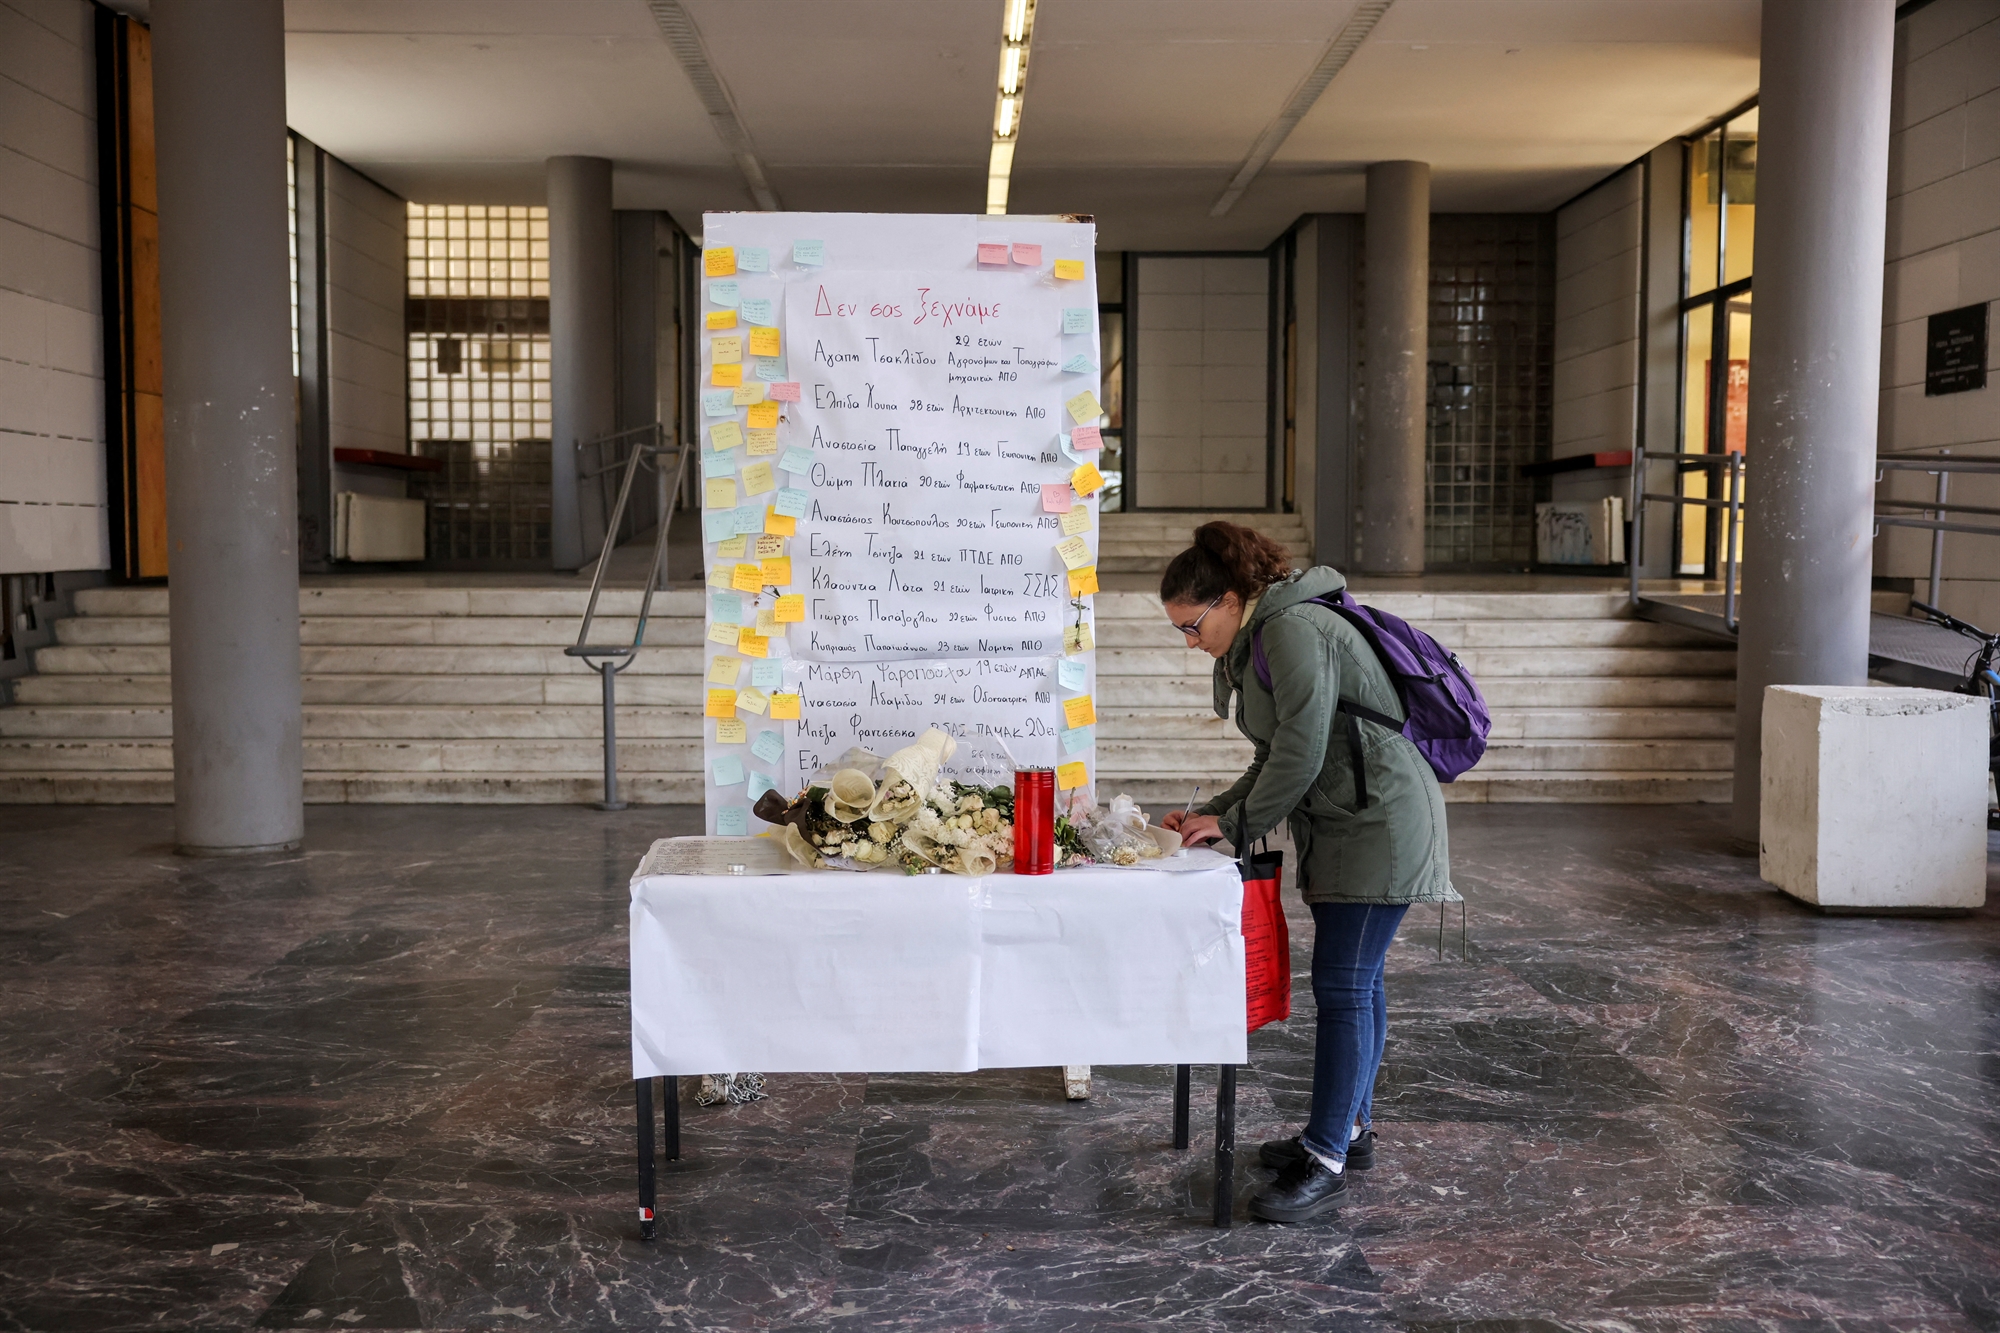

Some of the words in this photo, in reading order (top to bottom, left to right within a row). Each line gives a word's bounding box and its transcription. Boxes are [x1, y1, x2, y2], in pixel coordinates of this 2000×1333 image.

[814, 284, 857, 317] Δεν
[870, 304, 903, 317] σας
[914, 288, 1000, 328] ξεχνάμε
[814, 339, 860, 368] Αγάπη
[865, 337, 936, 364] Τσακλίδου
[1013, 347, 1058, 369] Τοπογράφων
[955, 335, 970, 347] 22
[978, 338, 1002, 347] ετών
[998, 371, 1018, 382] ΑΠΘ
[814, 384, 859, 409] Ελπίδα
[909, 399, 923, 411] 28
[926, 403, 944, 412] ετών
[952, 394, 1017, 417] Αρχιτεκτονική
[1025, 405, 1046, 419] ΑΠΘ
[812, 424, 876, 451] Αναστασία
[886, 428, 947, 460] Παπαγγελή
[957, 441, 970, 456] 19
[974, 448, 991, 457] ετών
[998, 441, 1036, 462] Γεωπονική
[1040, 451, 1058, 463] ΑΠΘ
[811, 462, 852, 491] Θώμη
[861, 462, 908, 488] Πλακιά
[919, 476, 932, 487] 20
[934, 480, 951, 489] ετών
[956, 469, 1015, 494] Φαρμακευτική
[1021, 481, 1040, 494] ΑΠΘ
[812, 499, 872, 524] Αναστάσιος
[882, 503, 949, 528] Κουτσόπουλος
[956, 518, 968, 527] 20
[969, 520, 986, 529] ετών
[992, 508, 1033, 529] Γεωπονική
[1037, 517, 1058, 529] ΑΠΘ
[811, 532, 852, 557] Ελένη
[914, 550, 924, 560] 21
[931, 554, 951, 562] ετών
[959, 548, 994, 565] ΠΤΔΕ
[1000, 553, 1023, 565] ΑΠΘ
[933, 580, 945, 592] 21
[950, 585, 970, 594] ετών
[980, 574, 1014, 596] Ιατρική
[1023, 573, 1058, 598] ΣΣΑΣ
[813, 598, 859, 626] Γιώργος
[868, 599, 938, 628] Παπάζογλου
[960, 615, 978, 623] ετών
[1024, 610, 1046, 622] ΑΠΘ
[811, 630, 857, 655] Κυπριανός
[937, 640, 950, 652] 23
[954, 644, 969, 652] ετών
[978, 639, 1014, 654] Νομική
[1021, 640, 1042, 651] ΑΠΘ
[808, 664, 862, 684] Μάρθη
[976, 660, 991, 676] 19
[994, 663, 1017, 673] ετών
[797, 681, 857, 708] Αναστασία
[934, 694, 946, 704] 24
[950, 695, 966, 704] ετών
[1035, 691, 1051, 703] ΑΠΘ
[798, 718, 836, 746] Μπέζα
[849, 713, 916, 742] Φραντσέσκα
[976, 723, 1024, 739] ΠΑΜΑΚ
[1025, 717, 1046, 737] 20
